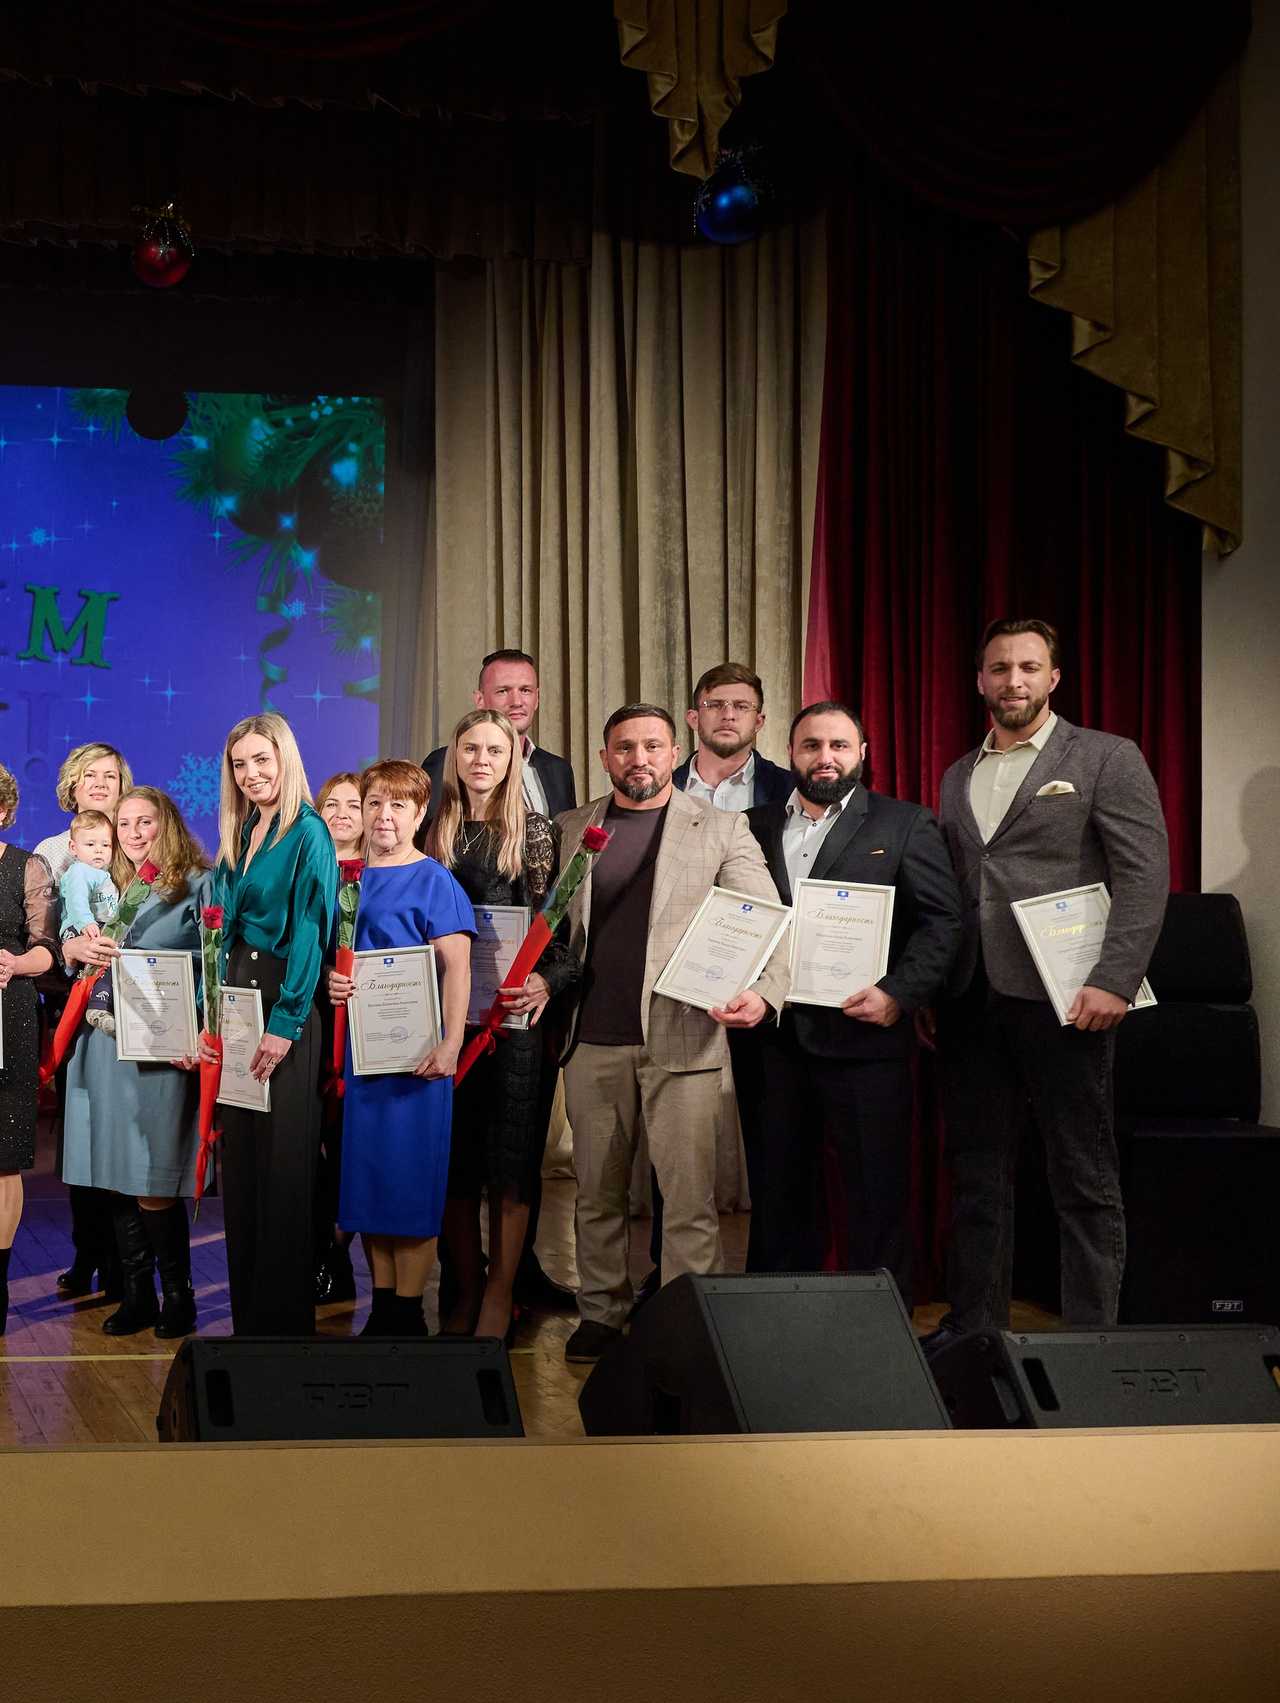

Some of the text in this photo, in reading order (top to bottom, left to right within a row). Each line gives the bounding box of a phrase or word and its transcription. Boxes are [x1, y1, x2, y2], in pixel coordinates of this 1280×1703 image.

[806, 908, 875, 925] Благодарность
[707, 916, 763, 939] Благодарность
[360, 979, 422, 992] Благодарность
[1215, 1302, 1240, 1310] FBT
[1111, 1368, 1207, 1397] FBT
